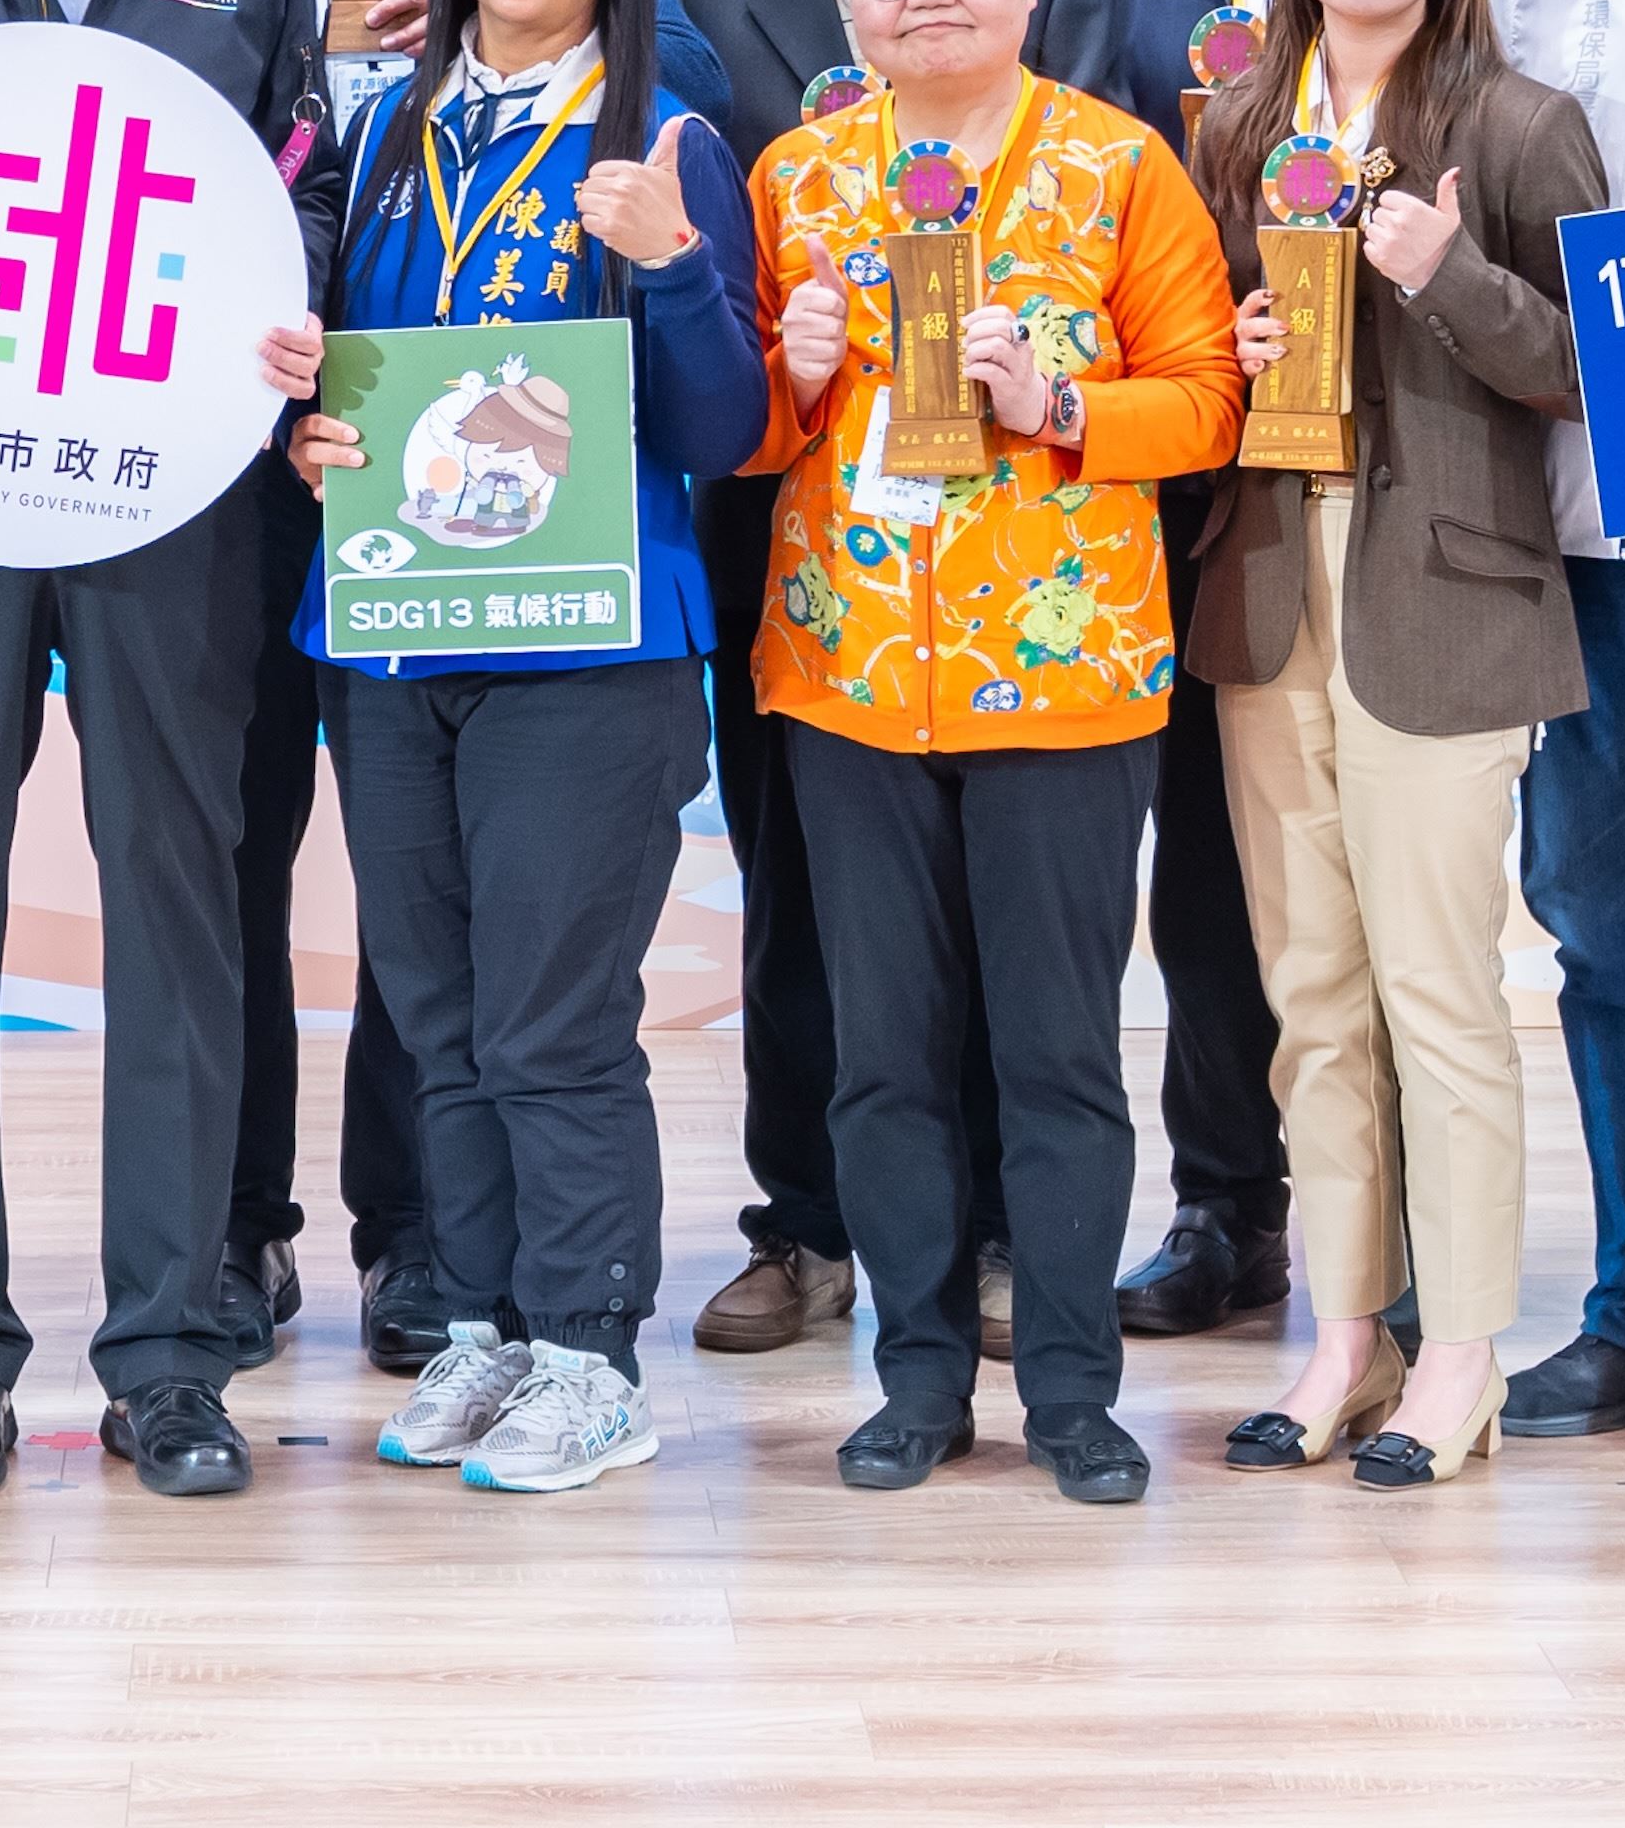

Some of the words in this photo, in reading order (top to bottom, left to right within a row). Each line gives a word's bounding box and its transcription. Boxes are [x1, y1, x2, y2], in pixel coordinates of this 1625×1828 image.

[480, 187, 546, 325] 陳美
[922, 312, 950, 341] 級
[1290, 307, 1317, 336] 級
[18, 492, 153, 523] GOVERNMENT
[348, 598, 474, 631] SDG13
[484, 590, 617, 628] 氣候行動
[578, 1402, 630, 1462] FILA
